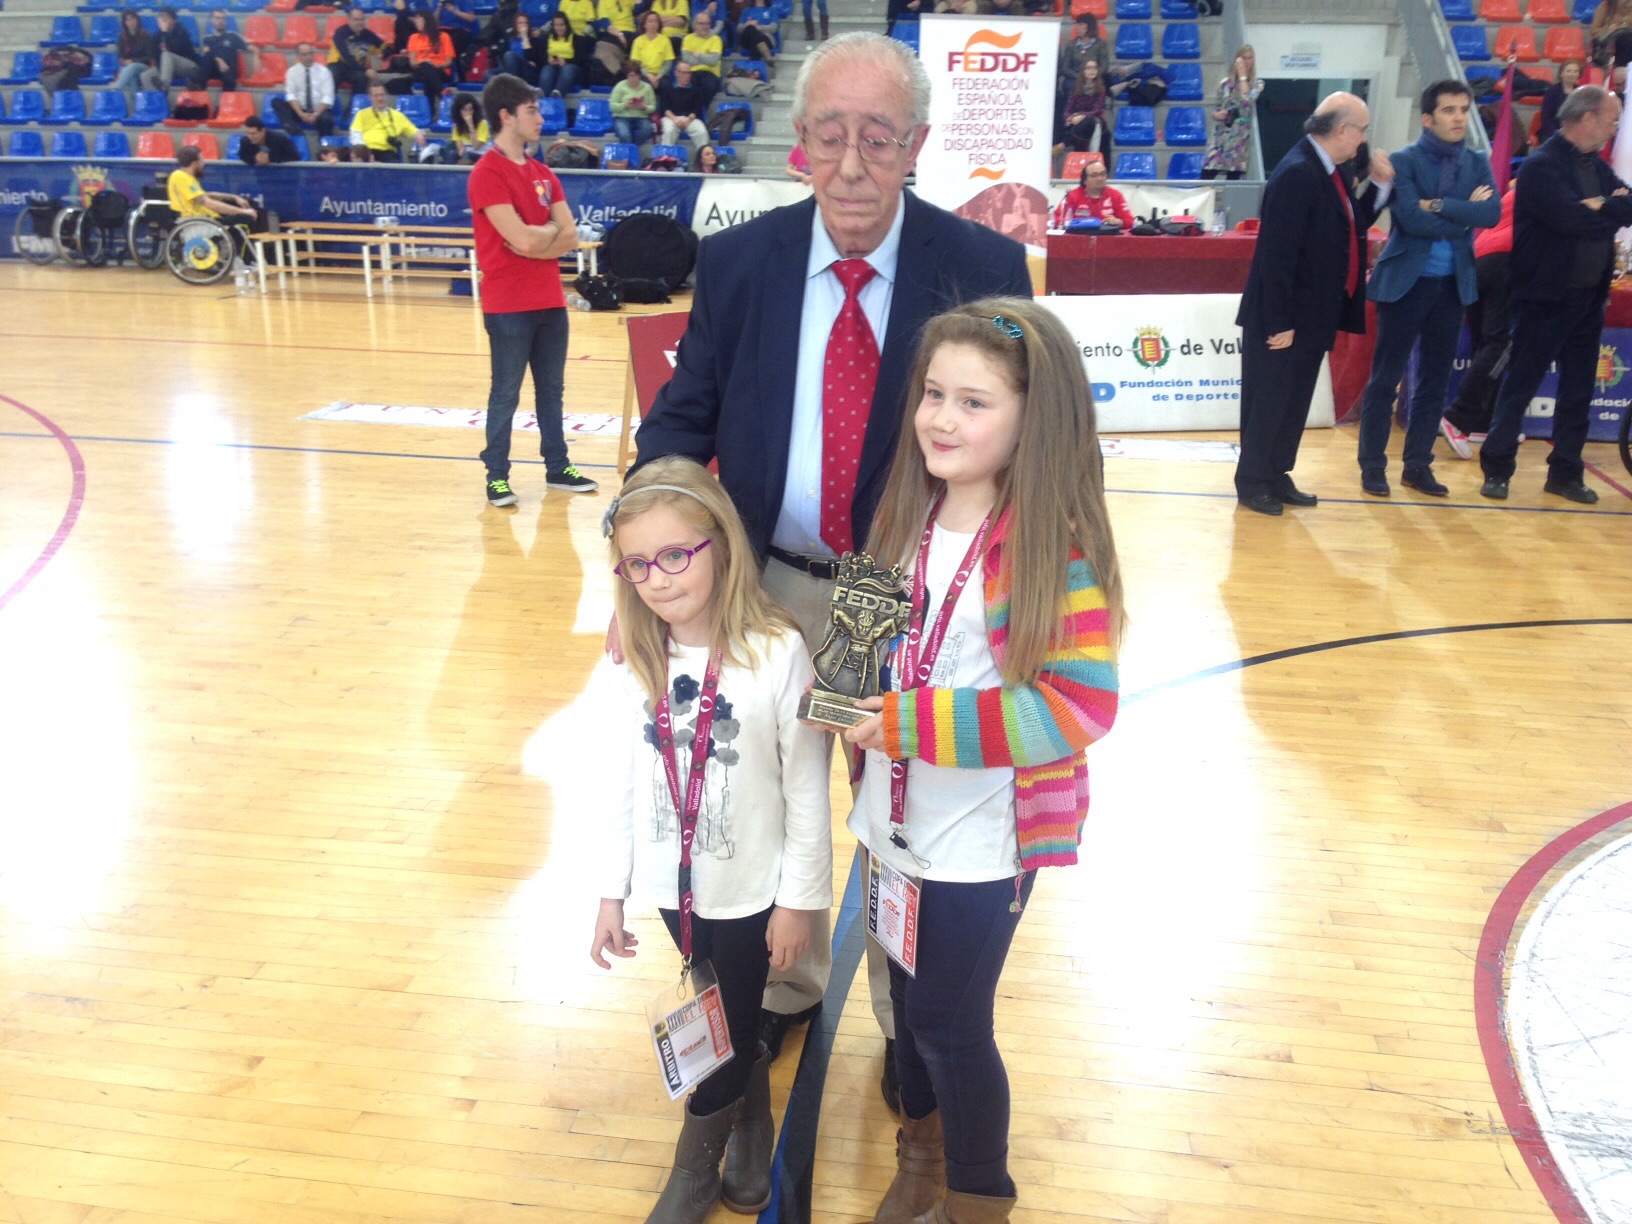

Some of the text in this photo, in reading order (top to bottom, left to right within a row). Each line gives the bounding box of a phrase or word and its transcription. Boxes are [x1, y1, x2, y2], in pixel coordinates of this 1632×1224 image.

[948, 52, 1038, 73] FEDDF
[952, 75, 1029, 90] FEDERACIÓN
[957, 91, 1023, 105] ESPAÑOLA
[963, 108, 1027, 121] DEPORTES
[951, 123, 1018, 136] PERSONAS
[944, 138, 1033, 151] DISCAPACIDAD
[968, 150, 1007, 165] FÍSICA
[320, 196, 448, 218] Ayuntamiento
[1180, 338, 1204, 356] de
[1120, 378, 1193, 389] Fundación
[1152, 391, 1239, 403] de Deporte
[1599, 411, 1620, 421] de
[832, 586, 914, 619] FEDDF
[929, 610, 943, 663] info.valladolid.es
[686, 785, 694, 809] Ayuntamiento
[691, 778, 702, 811] Valladolid
